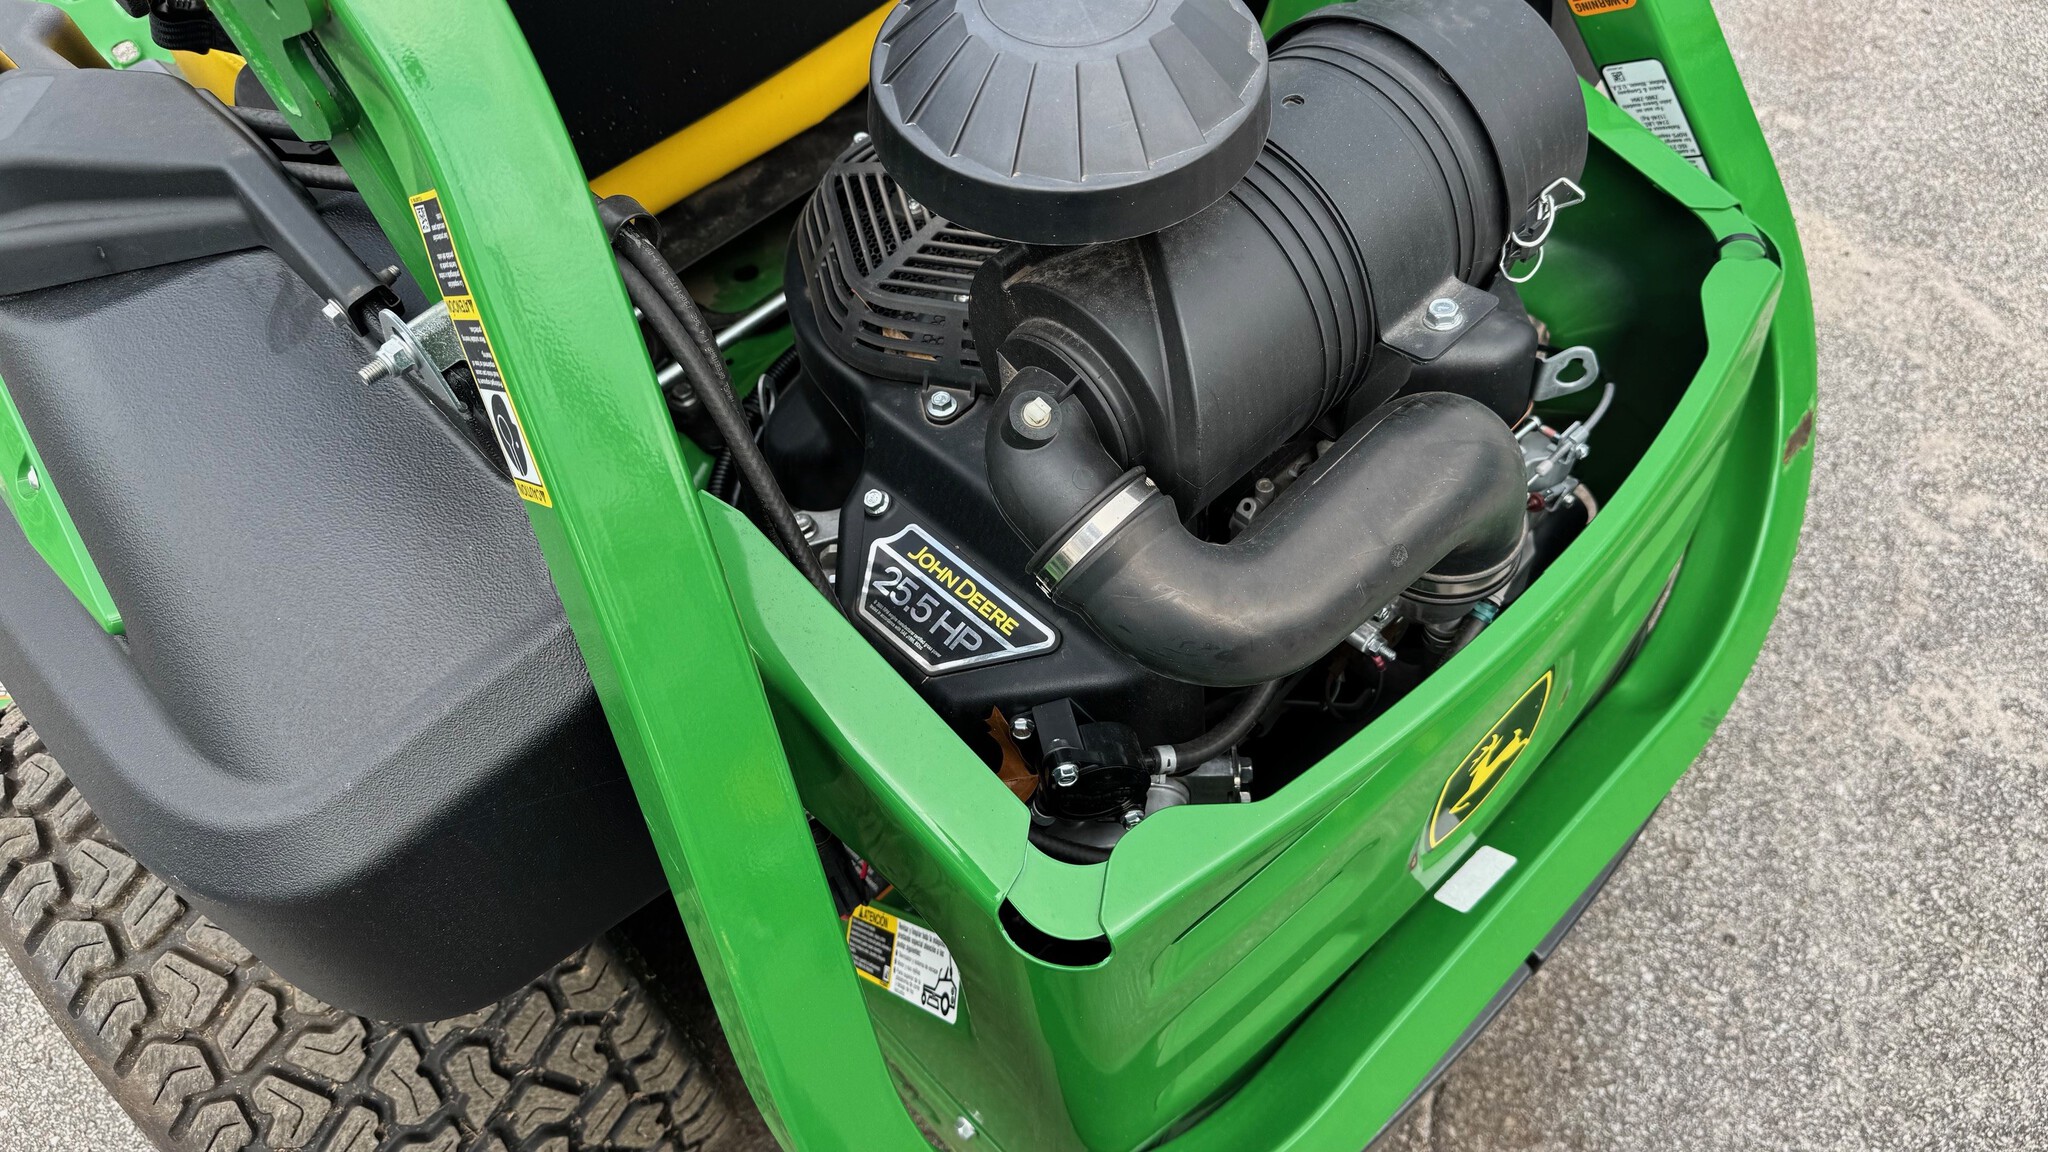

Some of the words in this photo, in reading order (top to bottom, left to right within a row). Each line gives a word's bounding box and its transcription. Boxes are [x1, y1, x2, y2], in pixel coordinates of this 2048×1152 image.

[1575, 0, 1620, 12] WARNING
[1618, 88, 1642, 97] Company
[517, 483, 542, 502] CAUTION
[907, 546, 960, 589] JOHN
[954, 578, 1020, 637] DEERE
[872, 566, 940, 623] 25.5
[929, 610, 983, 651] HP
[865, 909, 888, 928] ATENCIÓN
